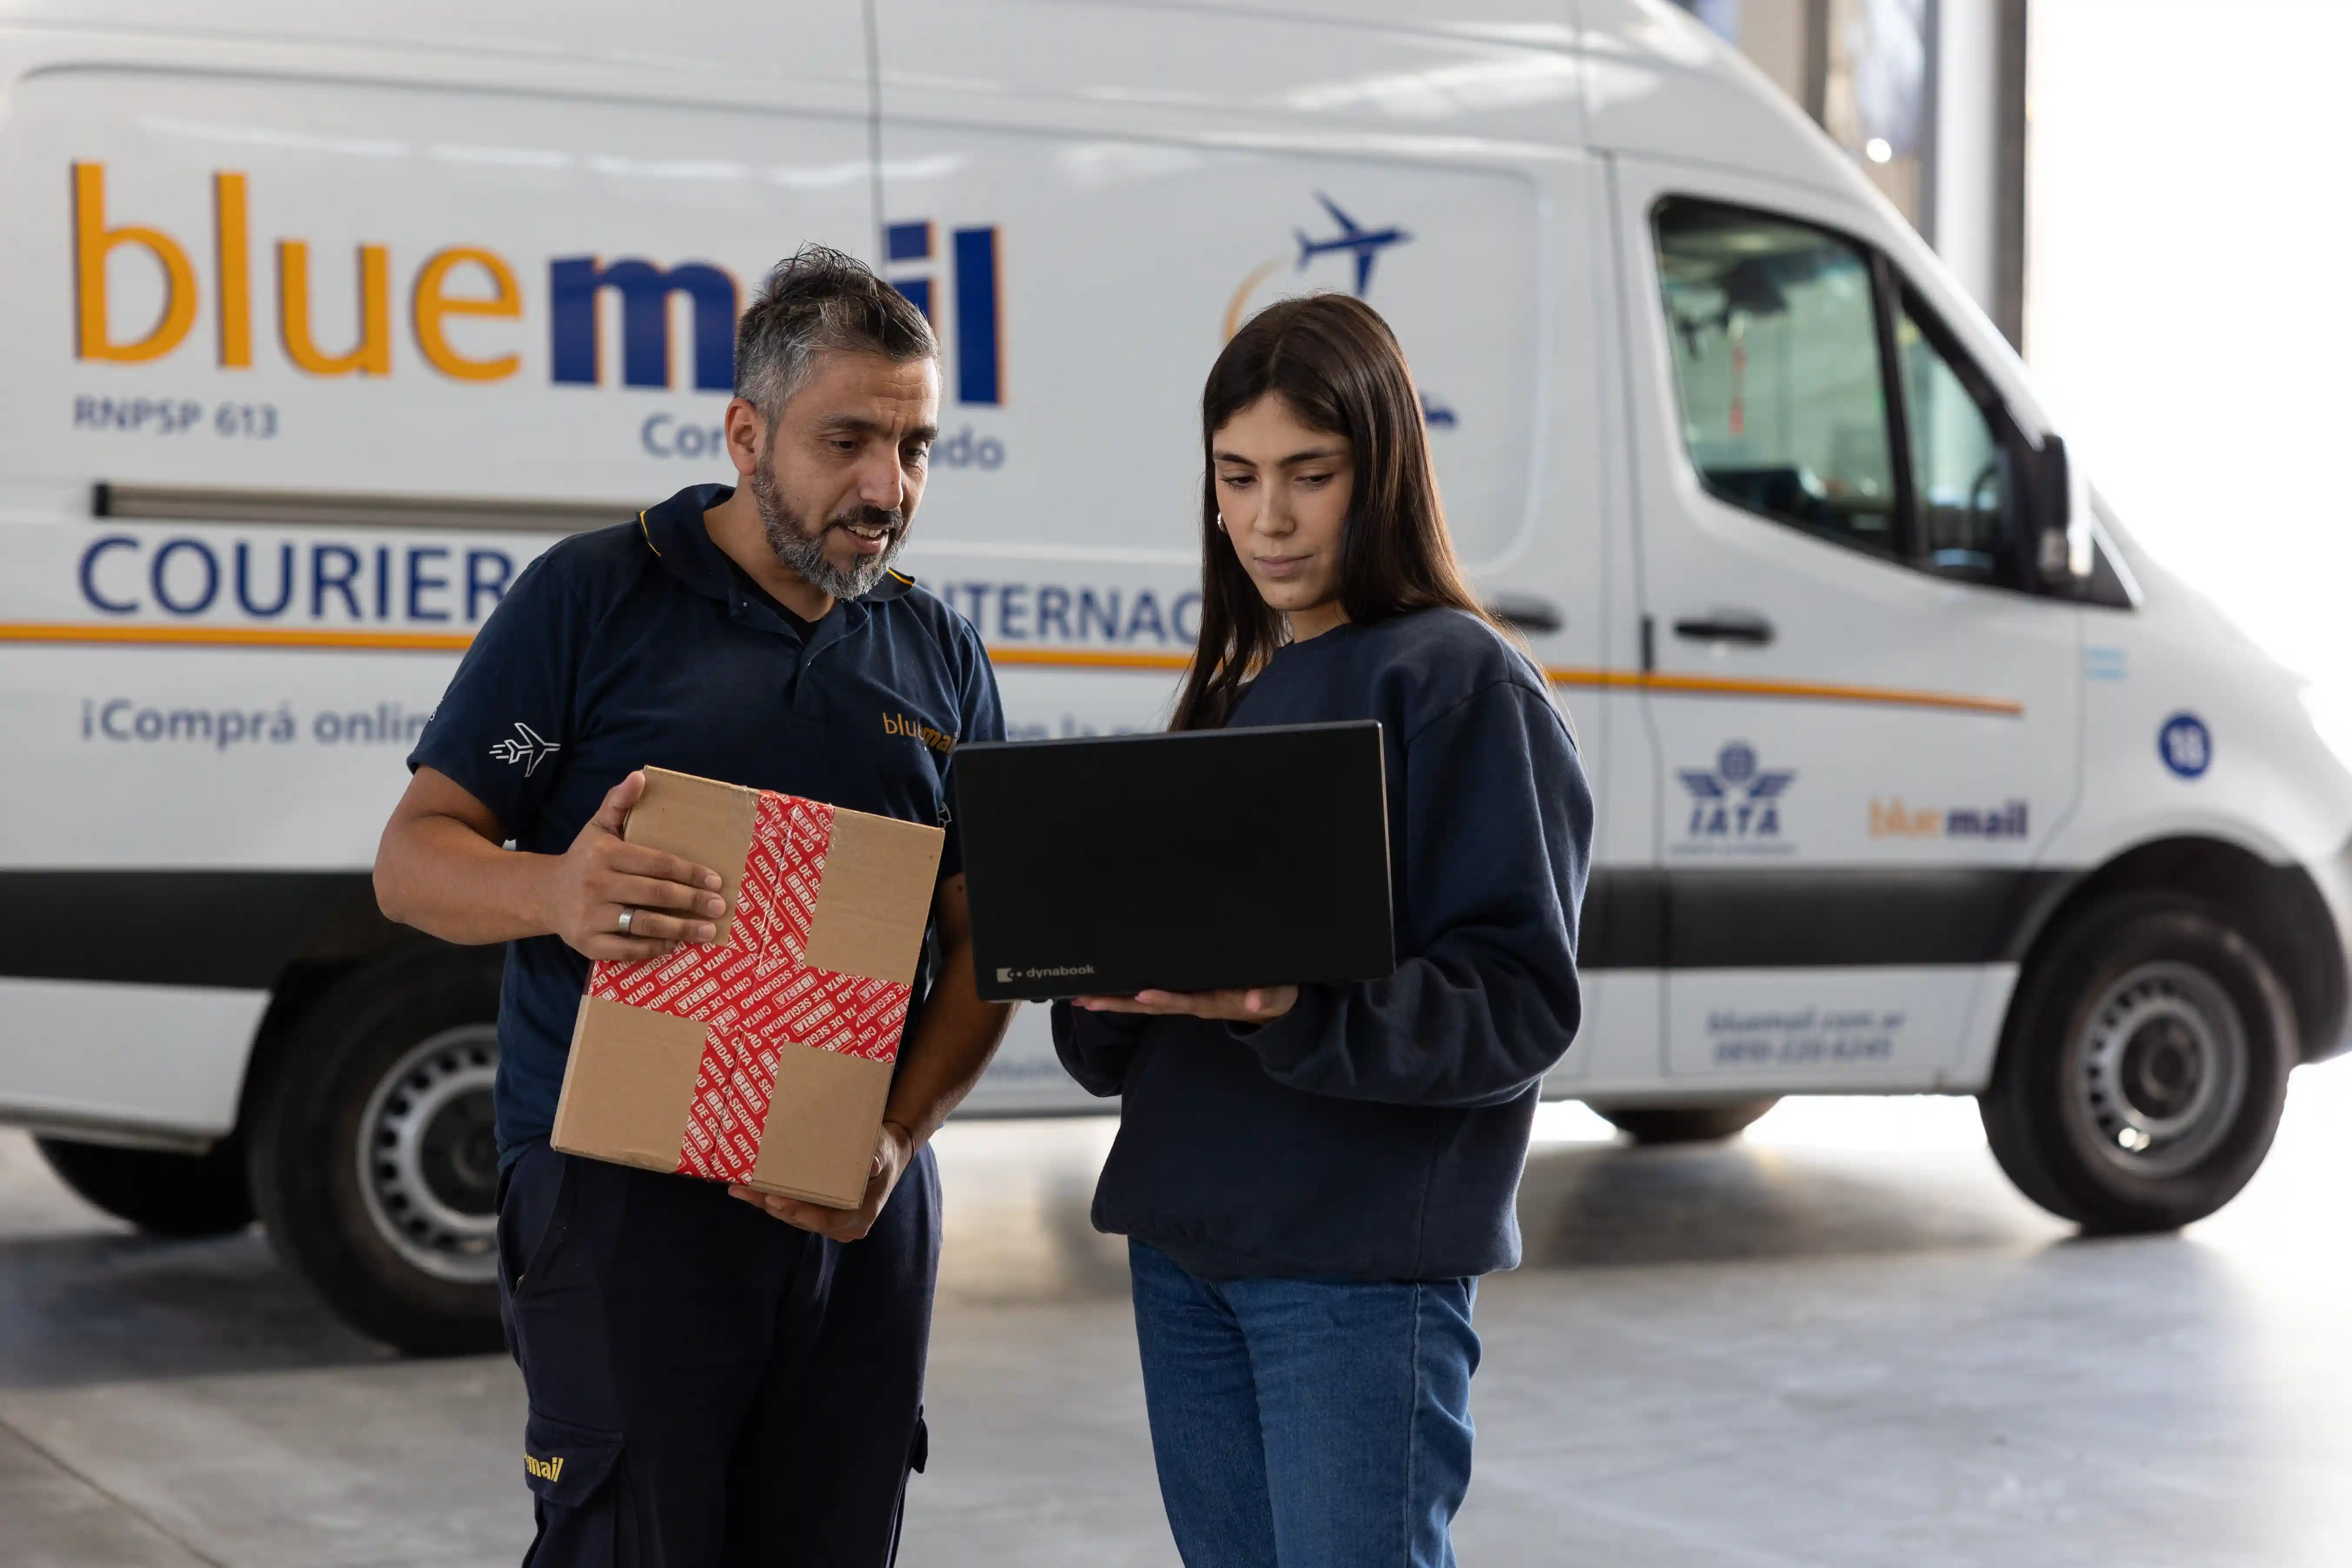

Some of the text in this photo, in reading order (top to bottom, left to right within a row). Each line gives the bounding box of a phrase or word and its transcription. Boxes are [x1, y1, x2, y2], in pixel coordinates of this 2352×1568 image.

[72, 162, 1006, 406] bluemil
[74, 396, 279, 439] RNPSP 613
[78, 535, 516, 623] COURIER
[790, 805, 823, 842] IBERIA
[1868, 796, 2029, 840] bluemail
[799, 863, 813, 879] DE
[754, 855, 776, 884] CINTA
[782, 896, 811, 936] SEGURID
[787, 874, 816, 915] IBERIA
[674, 941, 687, 955] DE
[703, 949, 733, 972] CINTA
[606, 960, 636, 978] INTA
[620, 953, 673, 990] SEGURIDAD
[658, 951, 699, 982] IBERIA
[689, 967, 705, 982] DE
[1026, 965, 1095, 978] dynabook
[625, 982, 655, 1005] CINTA
[641, 977, 691, 1011] SEGURIDA
[677, 979, 718, 1011] IBERIA
[708, 977, 752, 1011] CINTA DE
[740, 970, 793, 1009] SEGURIDAD
[775, 974, 815, 1005] IBERIA
[810, 988, 826, 1002] DE
[824, 973, 849, 992] INTA
[742, 1005, 772, 1028] CINTA
[760, 998, 812, 1037] SEGURIDAD
[793, 1002, 834, 1033] IBERIA
[829, 1015, 845, 1030] DE
[748, 1064, 763, 1081] DE
[703, 1057, 726, 1086] CINTA
[730, 1098, 762, 1147] SEGURIDA
[733, 1071, 762, 1111] IBERIA
[706, 1091, 733, 1130] IBERIA
[695, 1103, 710, 1119] DE
[705, 1117, 742, 1169] SEGURIDAD
[734, 1134, 756, 1164] CINTA
[524, 1454, 564, 1483] mail
